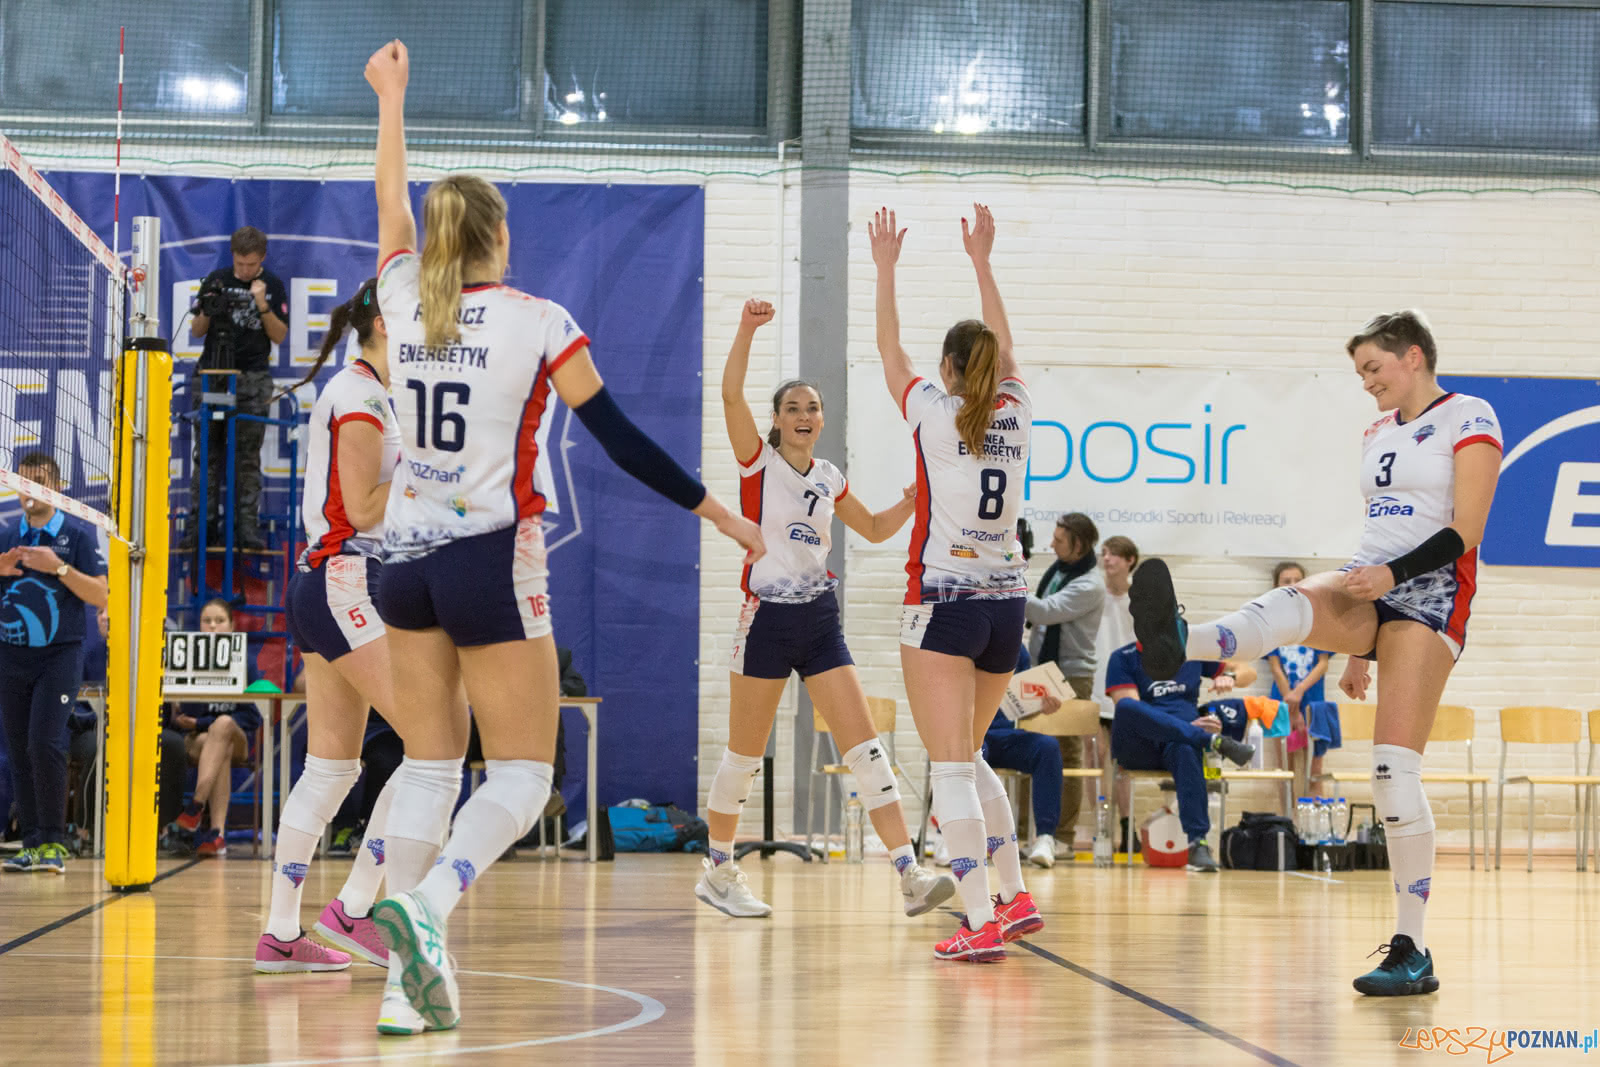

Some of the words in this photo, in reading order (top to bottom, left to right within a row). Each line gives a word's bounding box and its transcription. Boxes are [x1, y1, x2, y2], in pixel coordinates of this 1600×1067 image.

[399, 343, 489, 369] ENERGETYK
[405, 378, 471, 453] 16
[958, 440, 1022, 460] ERGETYK
[985, 433, 1005, 446] NEA
[1023, 404, 1247, 501] posir
[1375, 452, 1397, 488] 3
[803, 489, 820, 517] 7
[977, 468, 1007, 521] 8
[1108, 508, 1163, 523] Ośrodki
[1167, 510, 1214, 526] Sportu
[1223, 511, 1287, 529] Rekreacji
[1368, 502, 1415, 519] Enea
[789, 527, 821, 546] Enea
[348, 607, 367, 629] 5
[527, 594, 545, 618] 16
